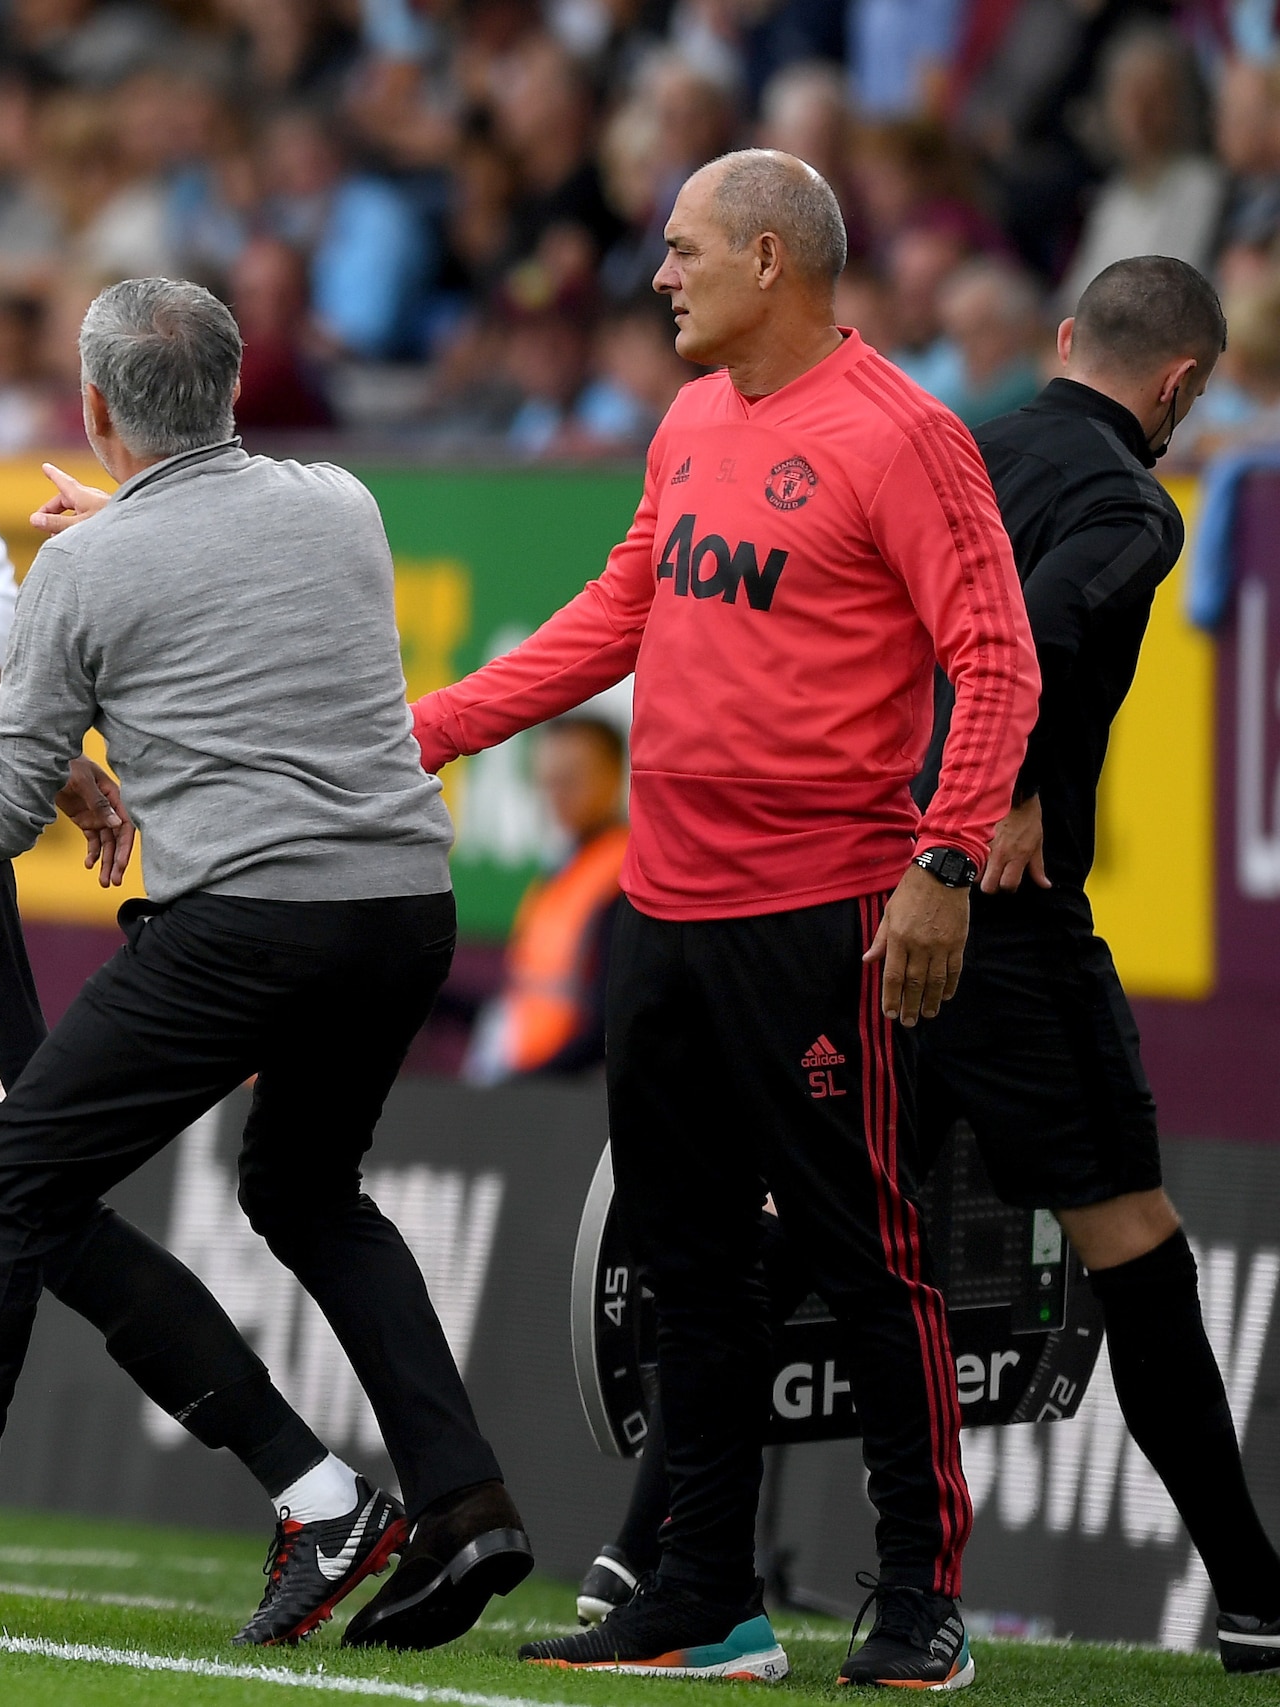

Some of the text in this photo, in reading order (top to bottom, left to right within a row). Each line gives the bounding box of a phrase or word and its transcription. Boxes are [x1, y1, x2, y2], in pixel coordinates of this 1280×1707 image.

[801, 1053, 846, 1067] adidas
[808, 1072, 847, 1099] SL
[604, 1266, 629, 1327] 45
[764, 1663, 779, 1677] SL
